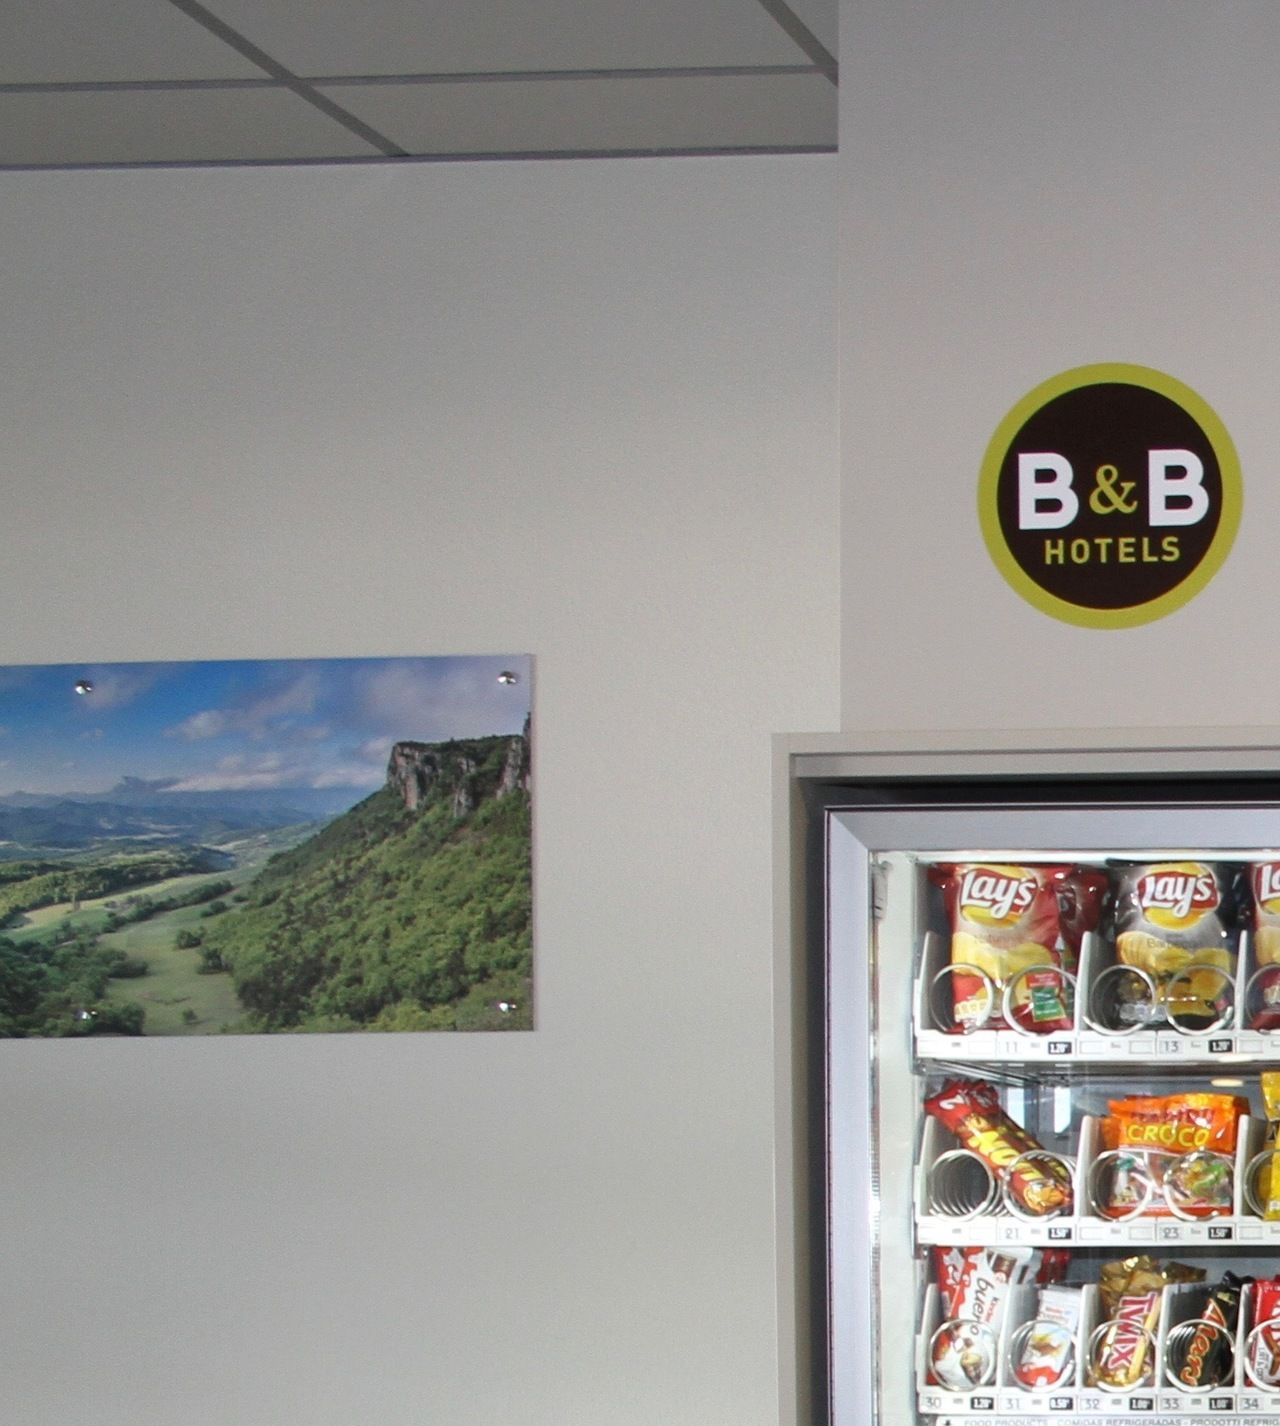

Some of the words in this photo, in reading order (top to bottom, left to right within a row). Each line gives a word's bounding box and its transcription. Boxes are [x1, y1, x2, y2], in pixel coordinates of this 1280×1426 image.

[1017, 449, 1209, 530] B&B
[1044, 536, 1181, 565] HOTELS
[1005, 1041, 1019, 1052] 11
[1164, 1039, 1180, 1051] 13
[1127, 1124, 1211, 1148] CROCO
[1005, 1228, 1019, 1239] 21
[1163, 1227, 1180, 1239] 23
[1110, 1293, 1158, 1370] TWIX
[1178, 1297, 1228, 1387] Mars
[925, 1397, 942, 1409] 30
[1005, 1398, 1021, 1410] 31
[1083, 1399, 1100, 1410] 32
[1163, 1398, 1180, 1410] 33
[1242, 1398, 1260, 1410] 34
[1057, 1418, 1104, 1426] COMIDAS
